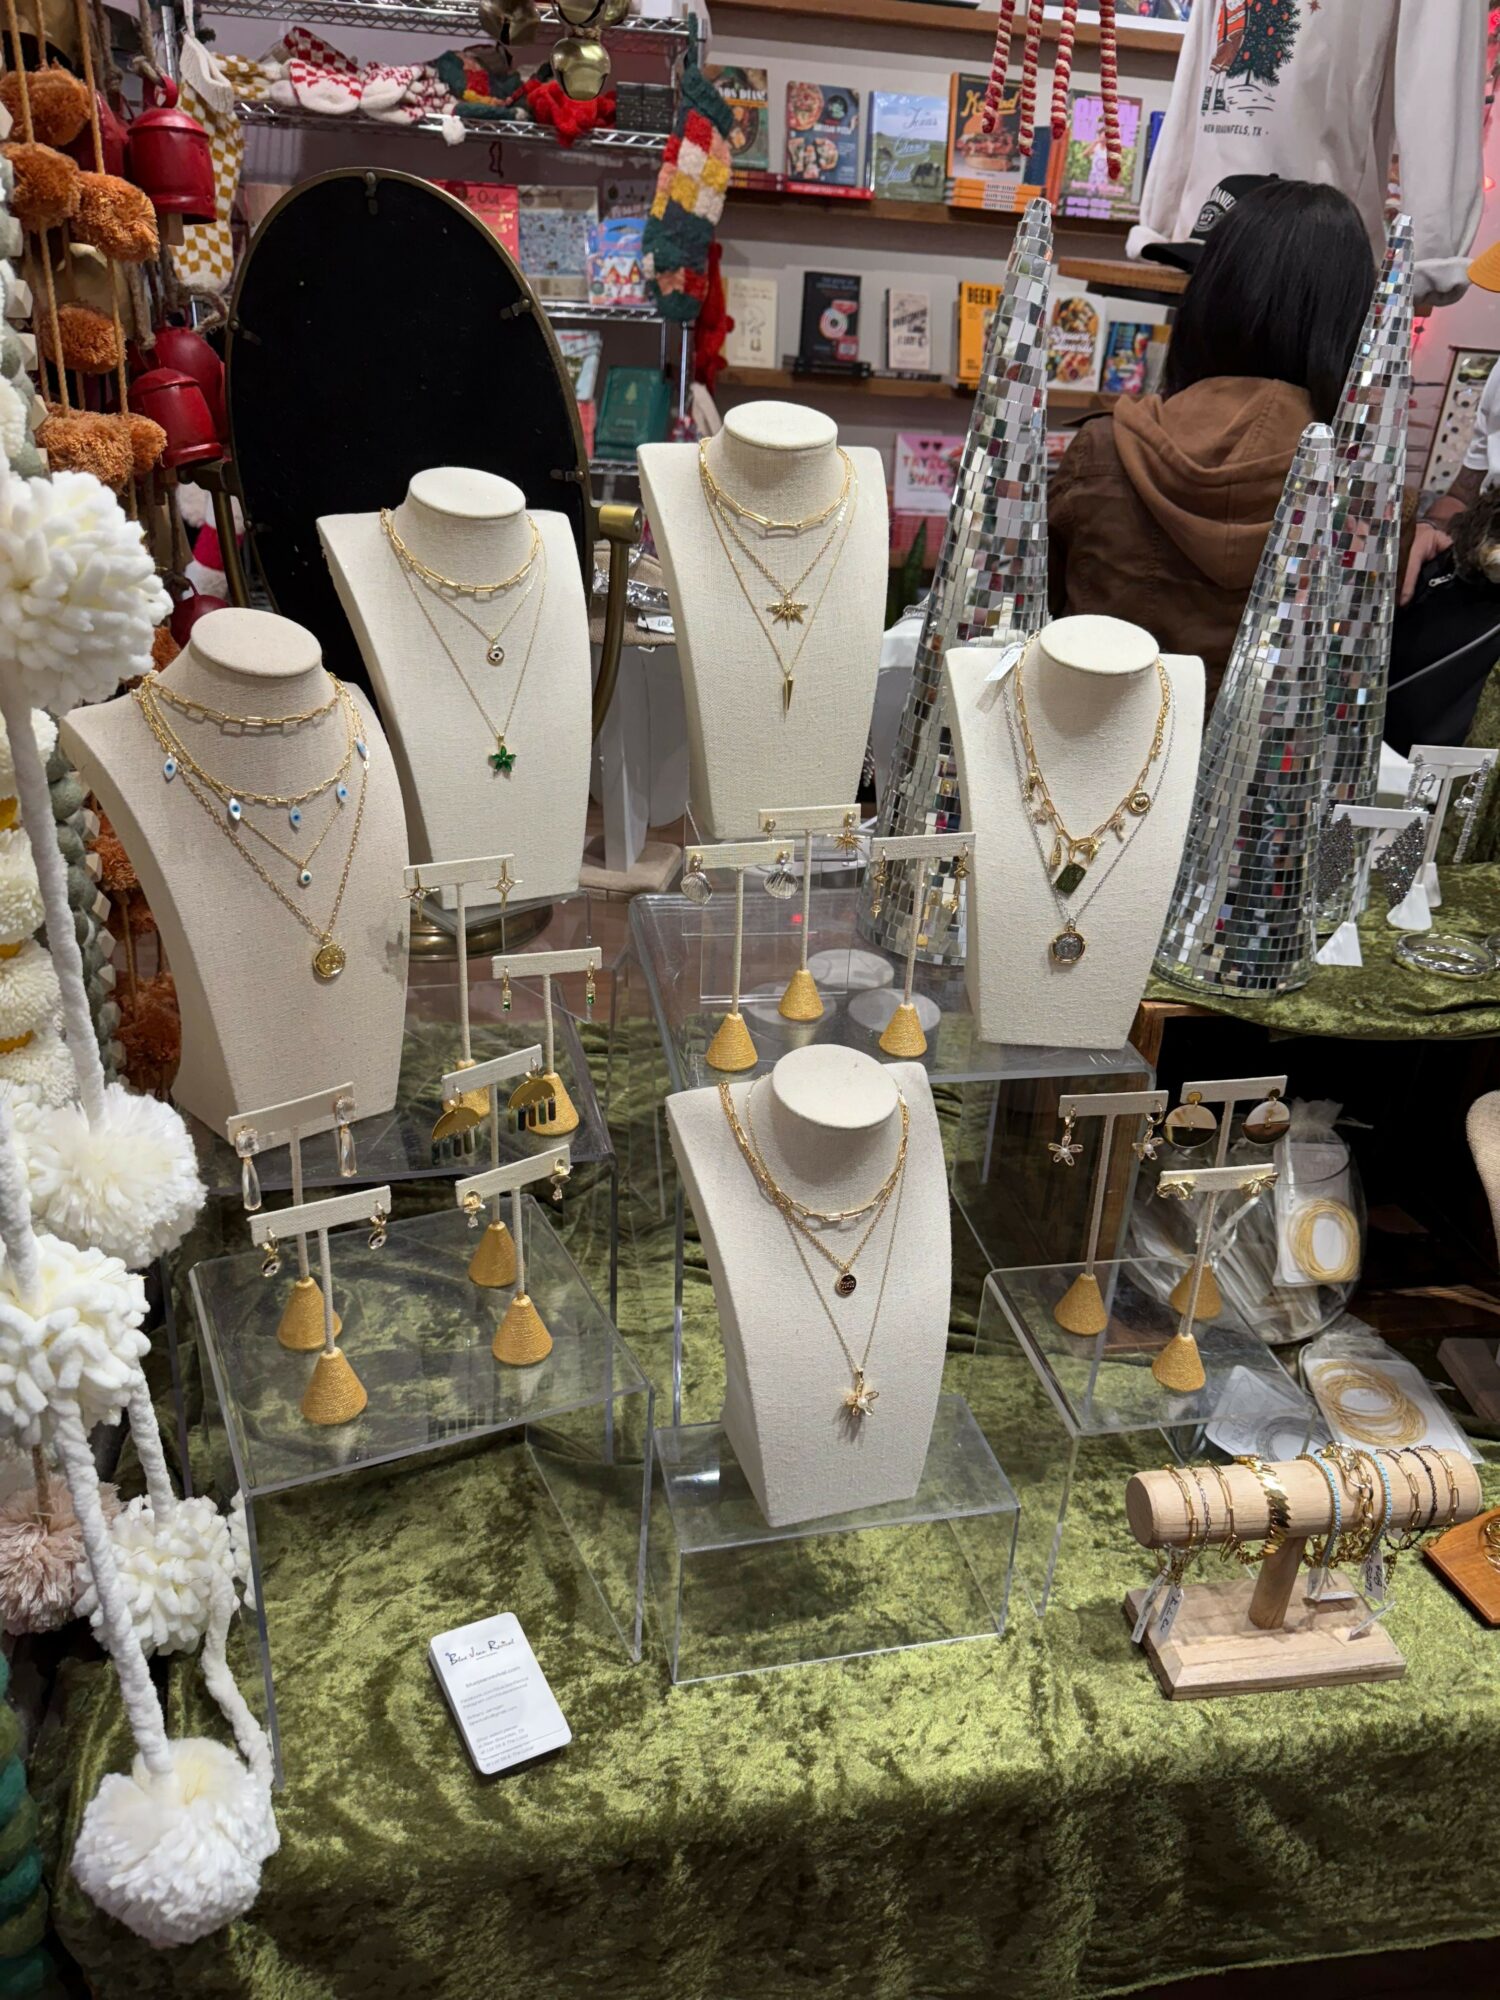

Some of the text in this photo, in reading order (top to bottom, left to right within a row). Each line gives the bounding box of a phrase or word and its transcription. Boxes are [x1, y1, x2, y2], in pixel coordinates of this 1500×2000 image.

[1203, 124, 1214, 134] NEW
[1252, 126, 1262, 137] TX
[967, 286, 993, 304] BEER
[448, 1653, 467, 1666] Blue
